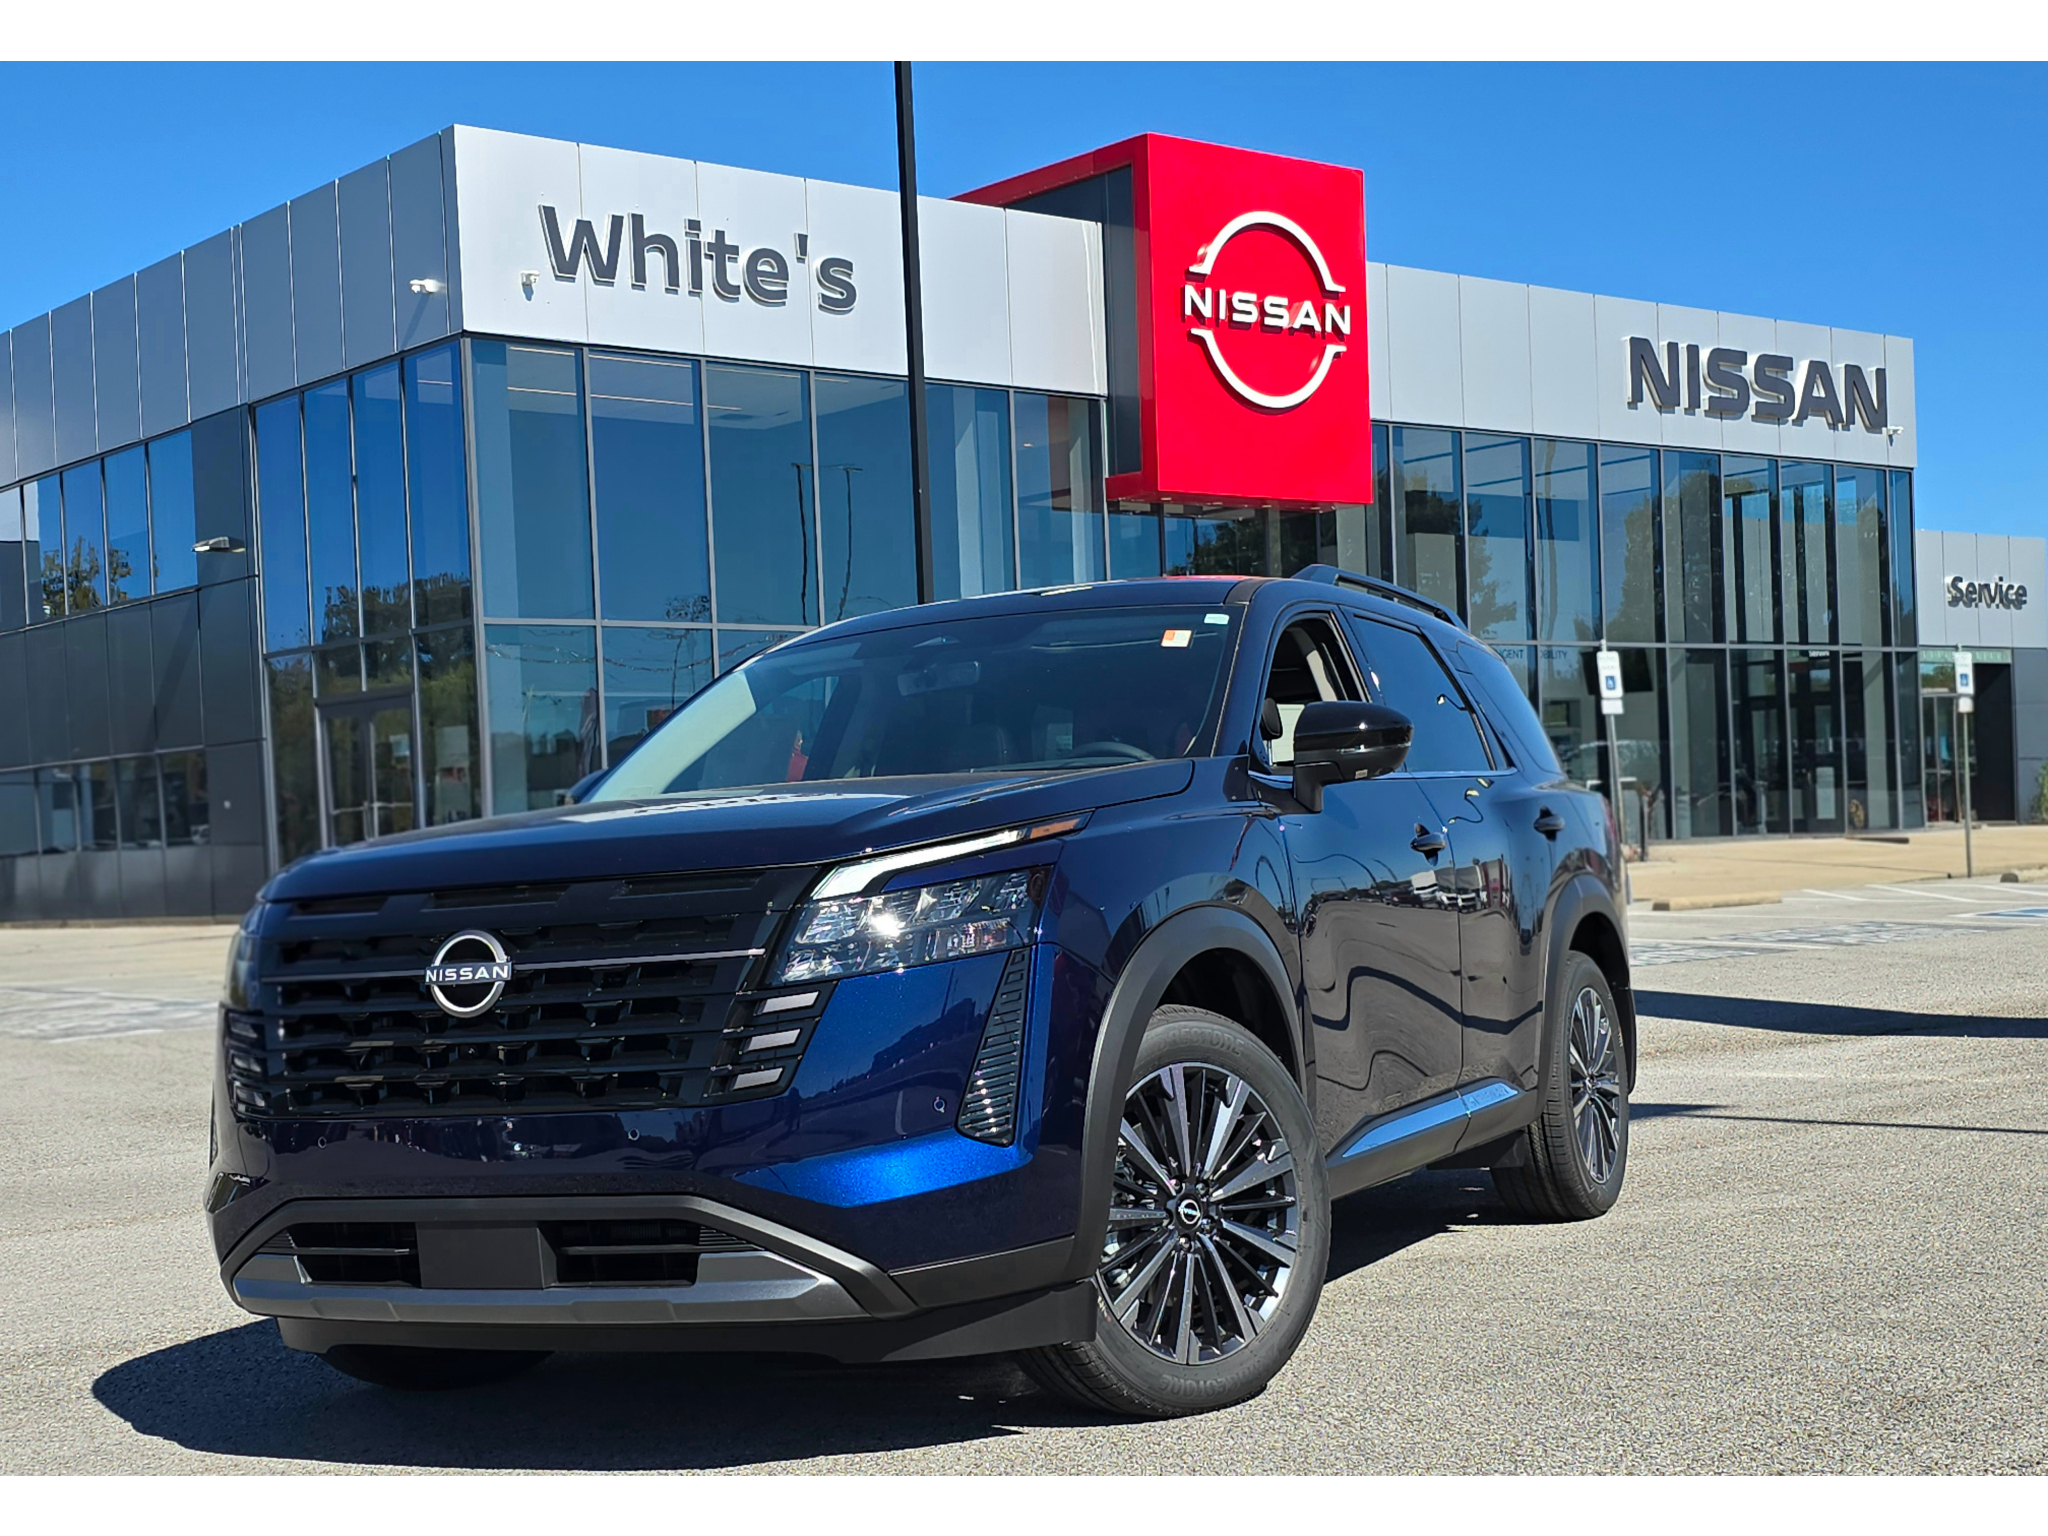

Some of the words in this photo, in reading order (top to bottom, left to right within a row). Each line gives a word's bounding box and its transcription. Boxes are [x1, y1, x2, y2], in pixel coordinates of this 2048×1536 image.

[538, 203, 857, 314] White's
[1184, 284, 1350, 335] NISSAN
[1626, 336, 1887, 430] NISSAN
[1949, 575, 2027, 607] Service
[425, 965, 509, 983] NISSAN
